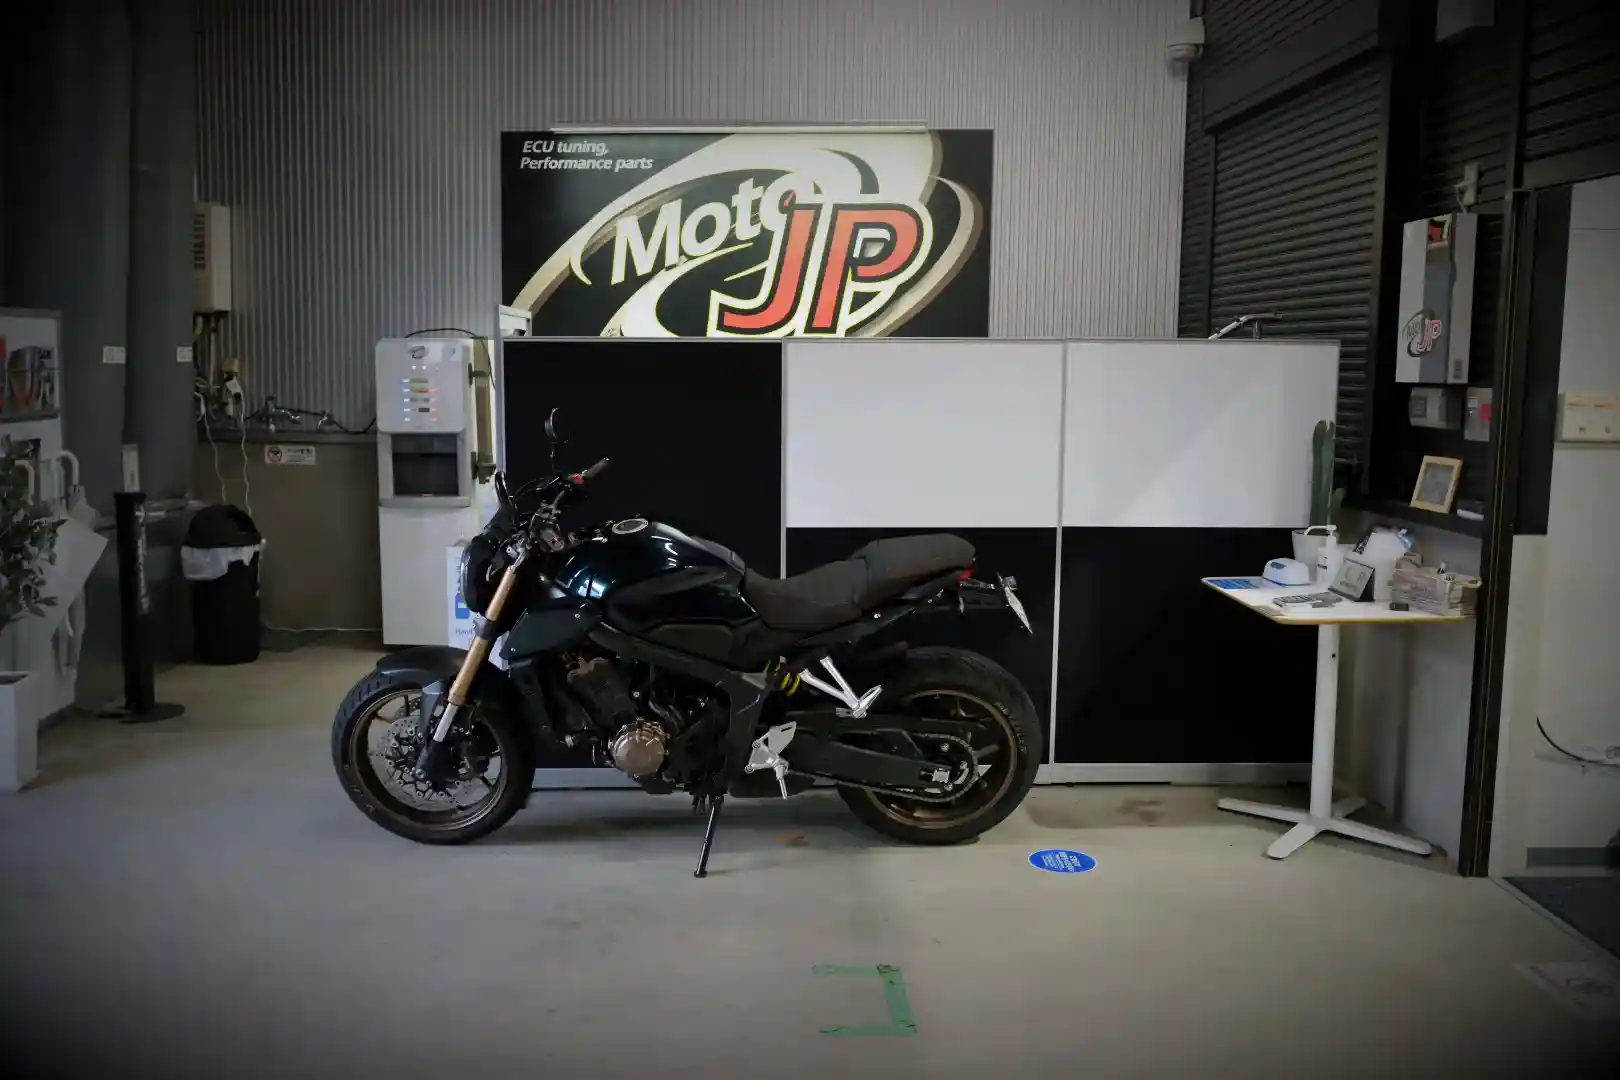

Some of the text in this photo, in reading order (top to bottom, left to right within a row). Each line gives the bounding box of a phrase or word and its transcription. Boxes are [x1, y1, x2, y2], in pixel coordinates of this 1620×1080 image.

[520, 156, 654, 173] Performance parts
[522, 140, 609, 157] ECU tuning,
[610, 171, 810, 286] Moto
[713, 203, 928, 334] JP
